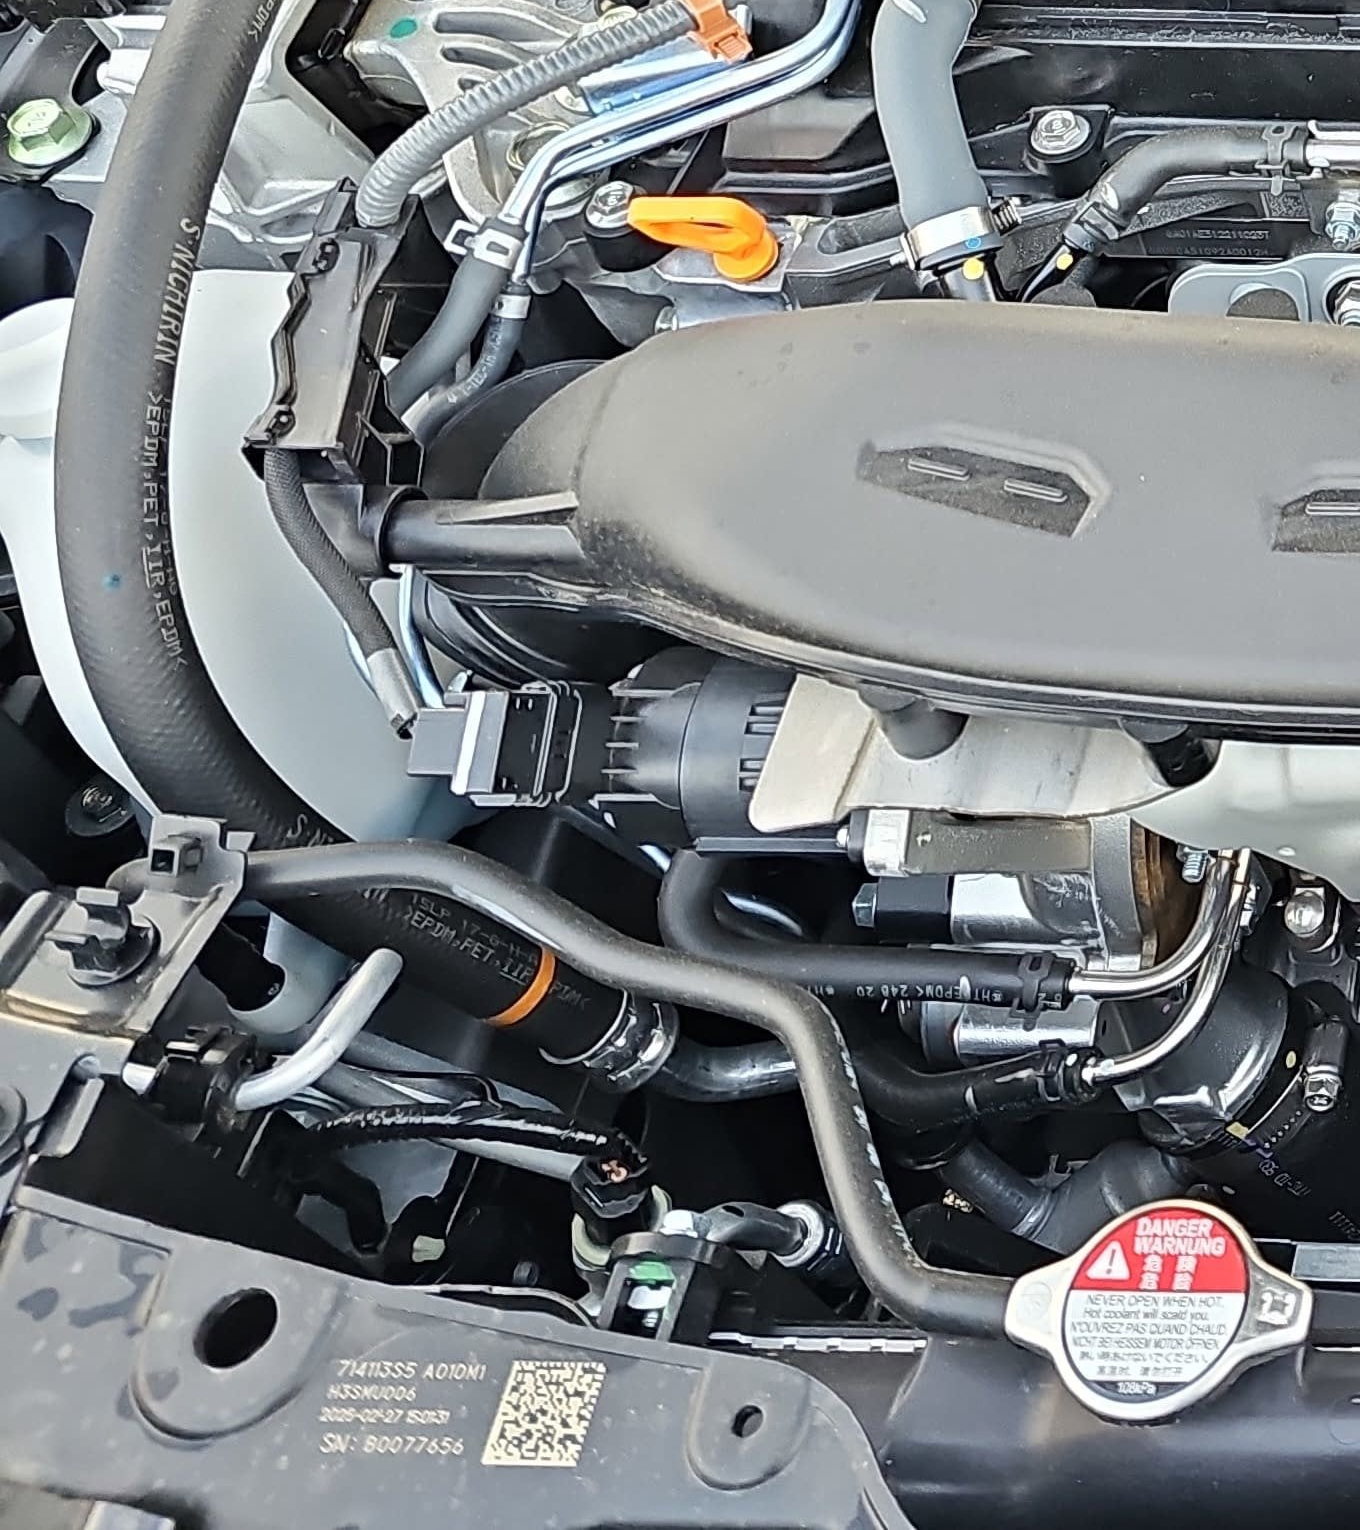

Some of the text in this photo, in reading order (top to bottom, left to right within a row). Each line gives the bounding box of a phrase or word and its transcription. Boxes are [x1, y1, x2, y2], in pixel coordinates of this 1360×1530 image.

[1136, 1217, 1213, 1238] DANGER
[1134, 1236, 1226, 1257] WARNUNG
[1087, 1294, 1126, 1307] NEVER
[1127, 1295, 1159, 1308] OPEN
[1162, 1296, 1195, 1308] WHEN
[1083, 1309, 1102, 1319] Hot
[1125, 1323, 1147, 1334] PAS
[319, 1432, 359, 1454] SN:
